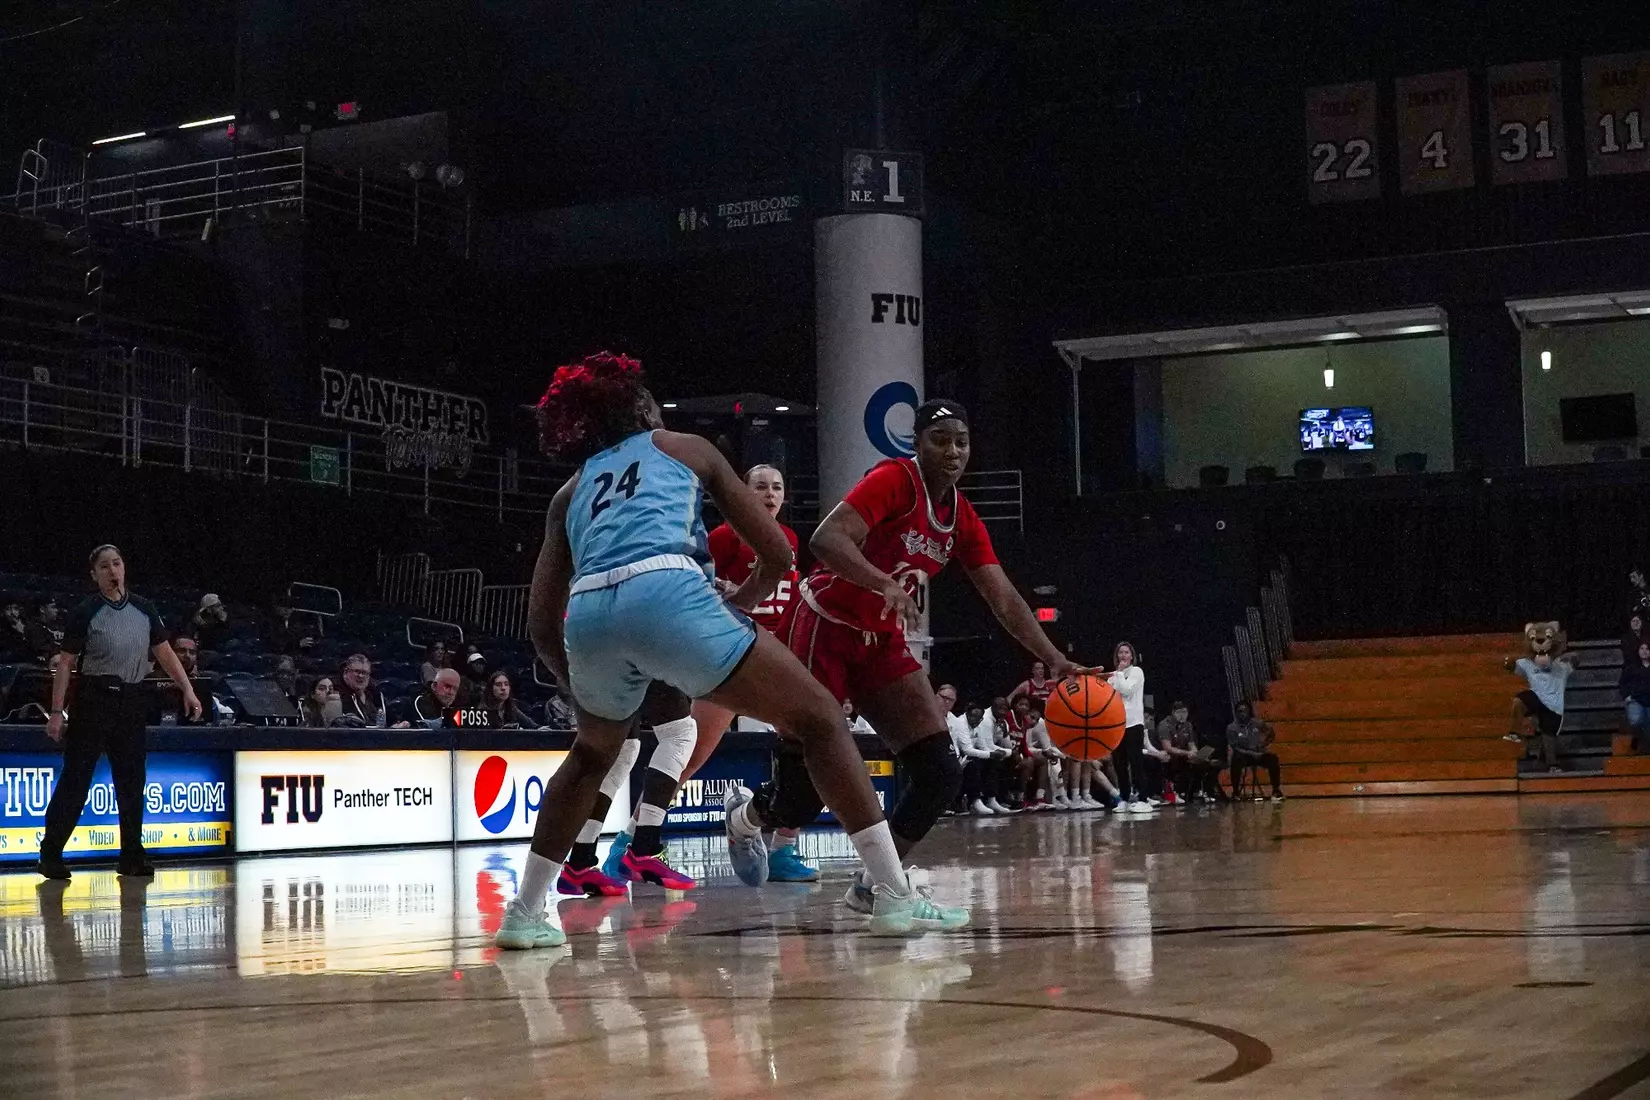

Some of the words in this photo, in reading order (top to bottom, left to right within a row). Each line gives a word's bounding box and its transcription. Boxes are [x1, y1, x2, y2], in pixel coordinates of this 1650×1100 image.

[1500, 120, 1556, 162] 31
[1599, 111, 1645, 153] 11
[1311, 139, 1373, 183] 22
[1421, 131, 1448, 168] 4
[850, 190, 875, 203] N.E.
[882, 161, 905, 203] 1
[718, 195, 799, 217] RESTROOMS
[726, 215, 749, 229] 2nd
[752, 207, 792, 226] LEVEL
[871, 293, 920, 326] FIU
[320, 365, 490, 446] PANTHER
[591, 461, 641, 520] 24
[461, 709, 490, 726] POSS.
[261, 775, 324, 825] FIU
[334, 788, 389, 808] Panther
[394, 787, 433, 806] TECH
[667, 813, 682, 823] PROUD
[683, 812, 702, 822] SPONSOR
[89, 829, 115, 846] VIDEO
[188, 828, 195, 842] &
[197, 827, 222, 842] MORE
